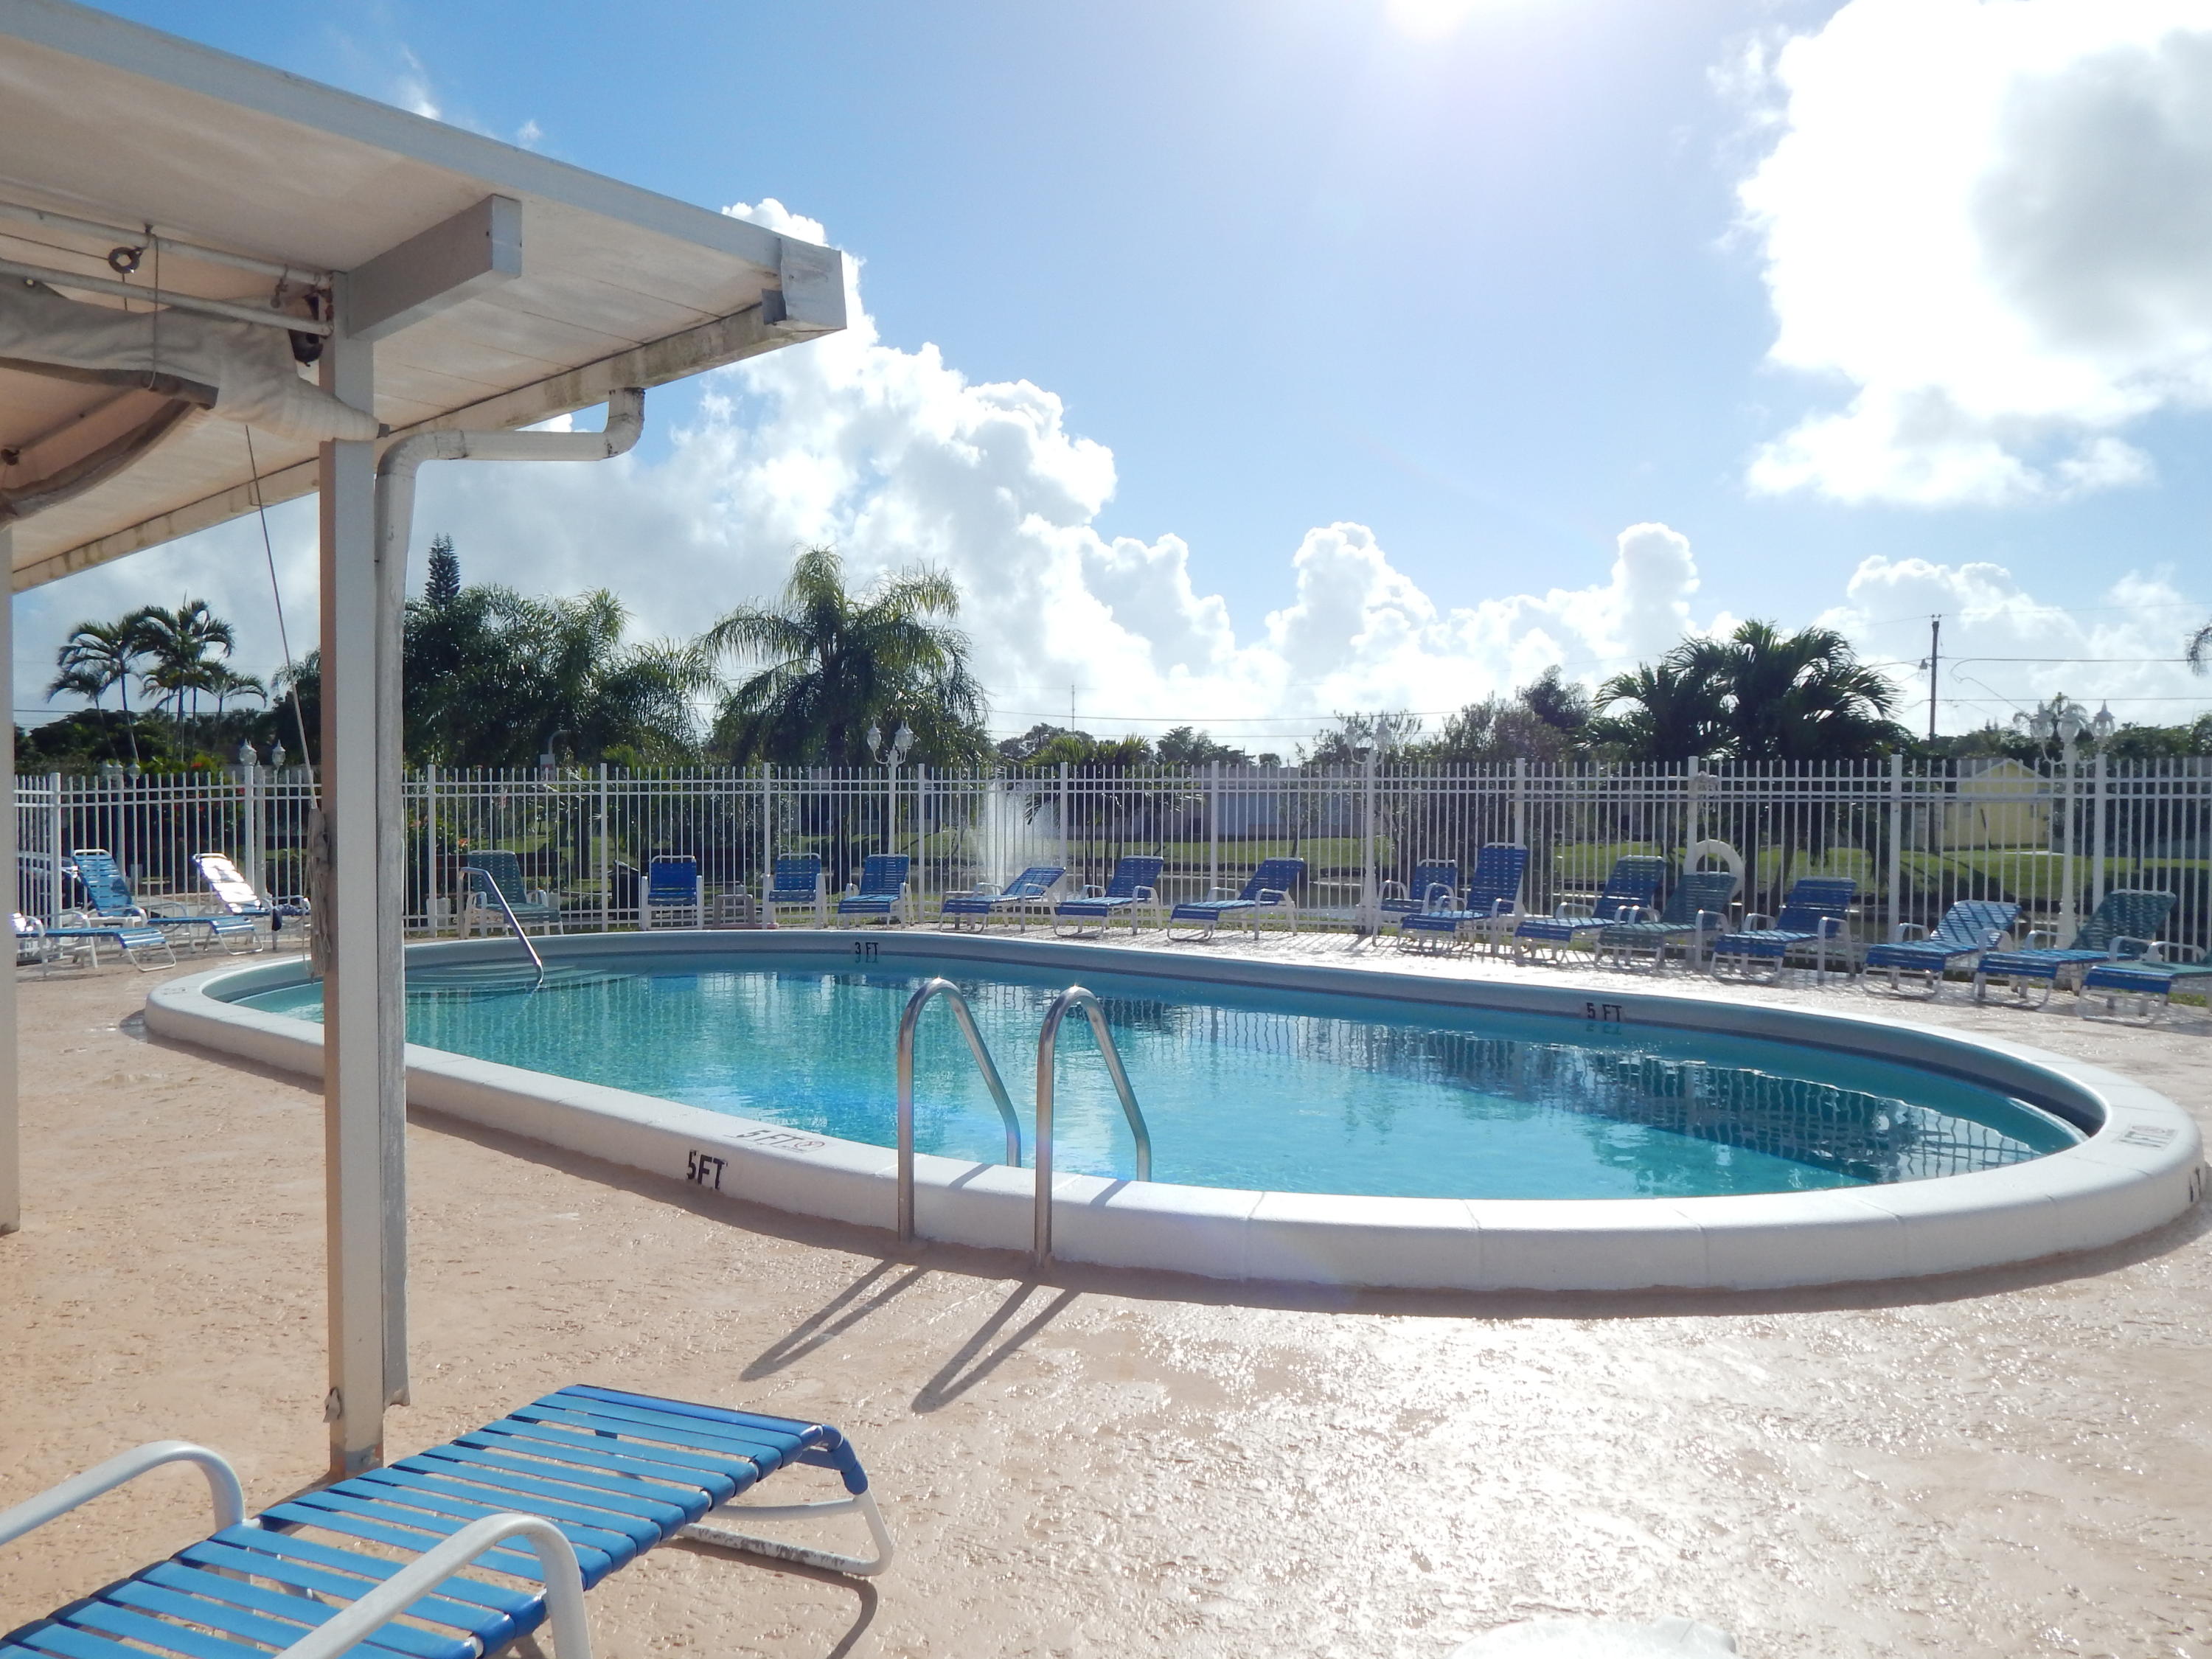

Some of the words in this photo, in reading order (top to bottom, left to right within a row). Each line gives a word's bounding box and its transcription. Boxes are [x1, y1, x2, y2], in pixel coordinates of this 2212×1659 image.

[855, 942, 861, 954] 3
[866, 942, 878, 955] FT
[1586, 1003, 1595, 1018] 5
[1602, 1004, 1622, 1022] FT
